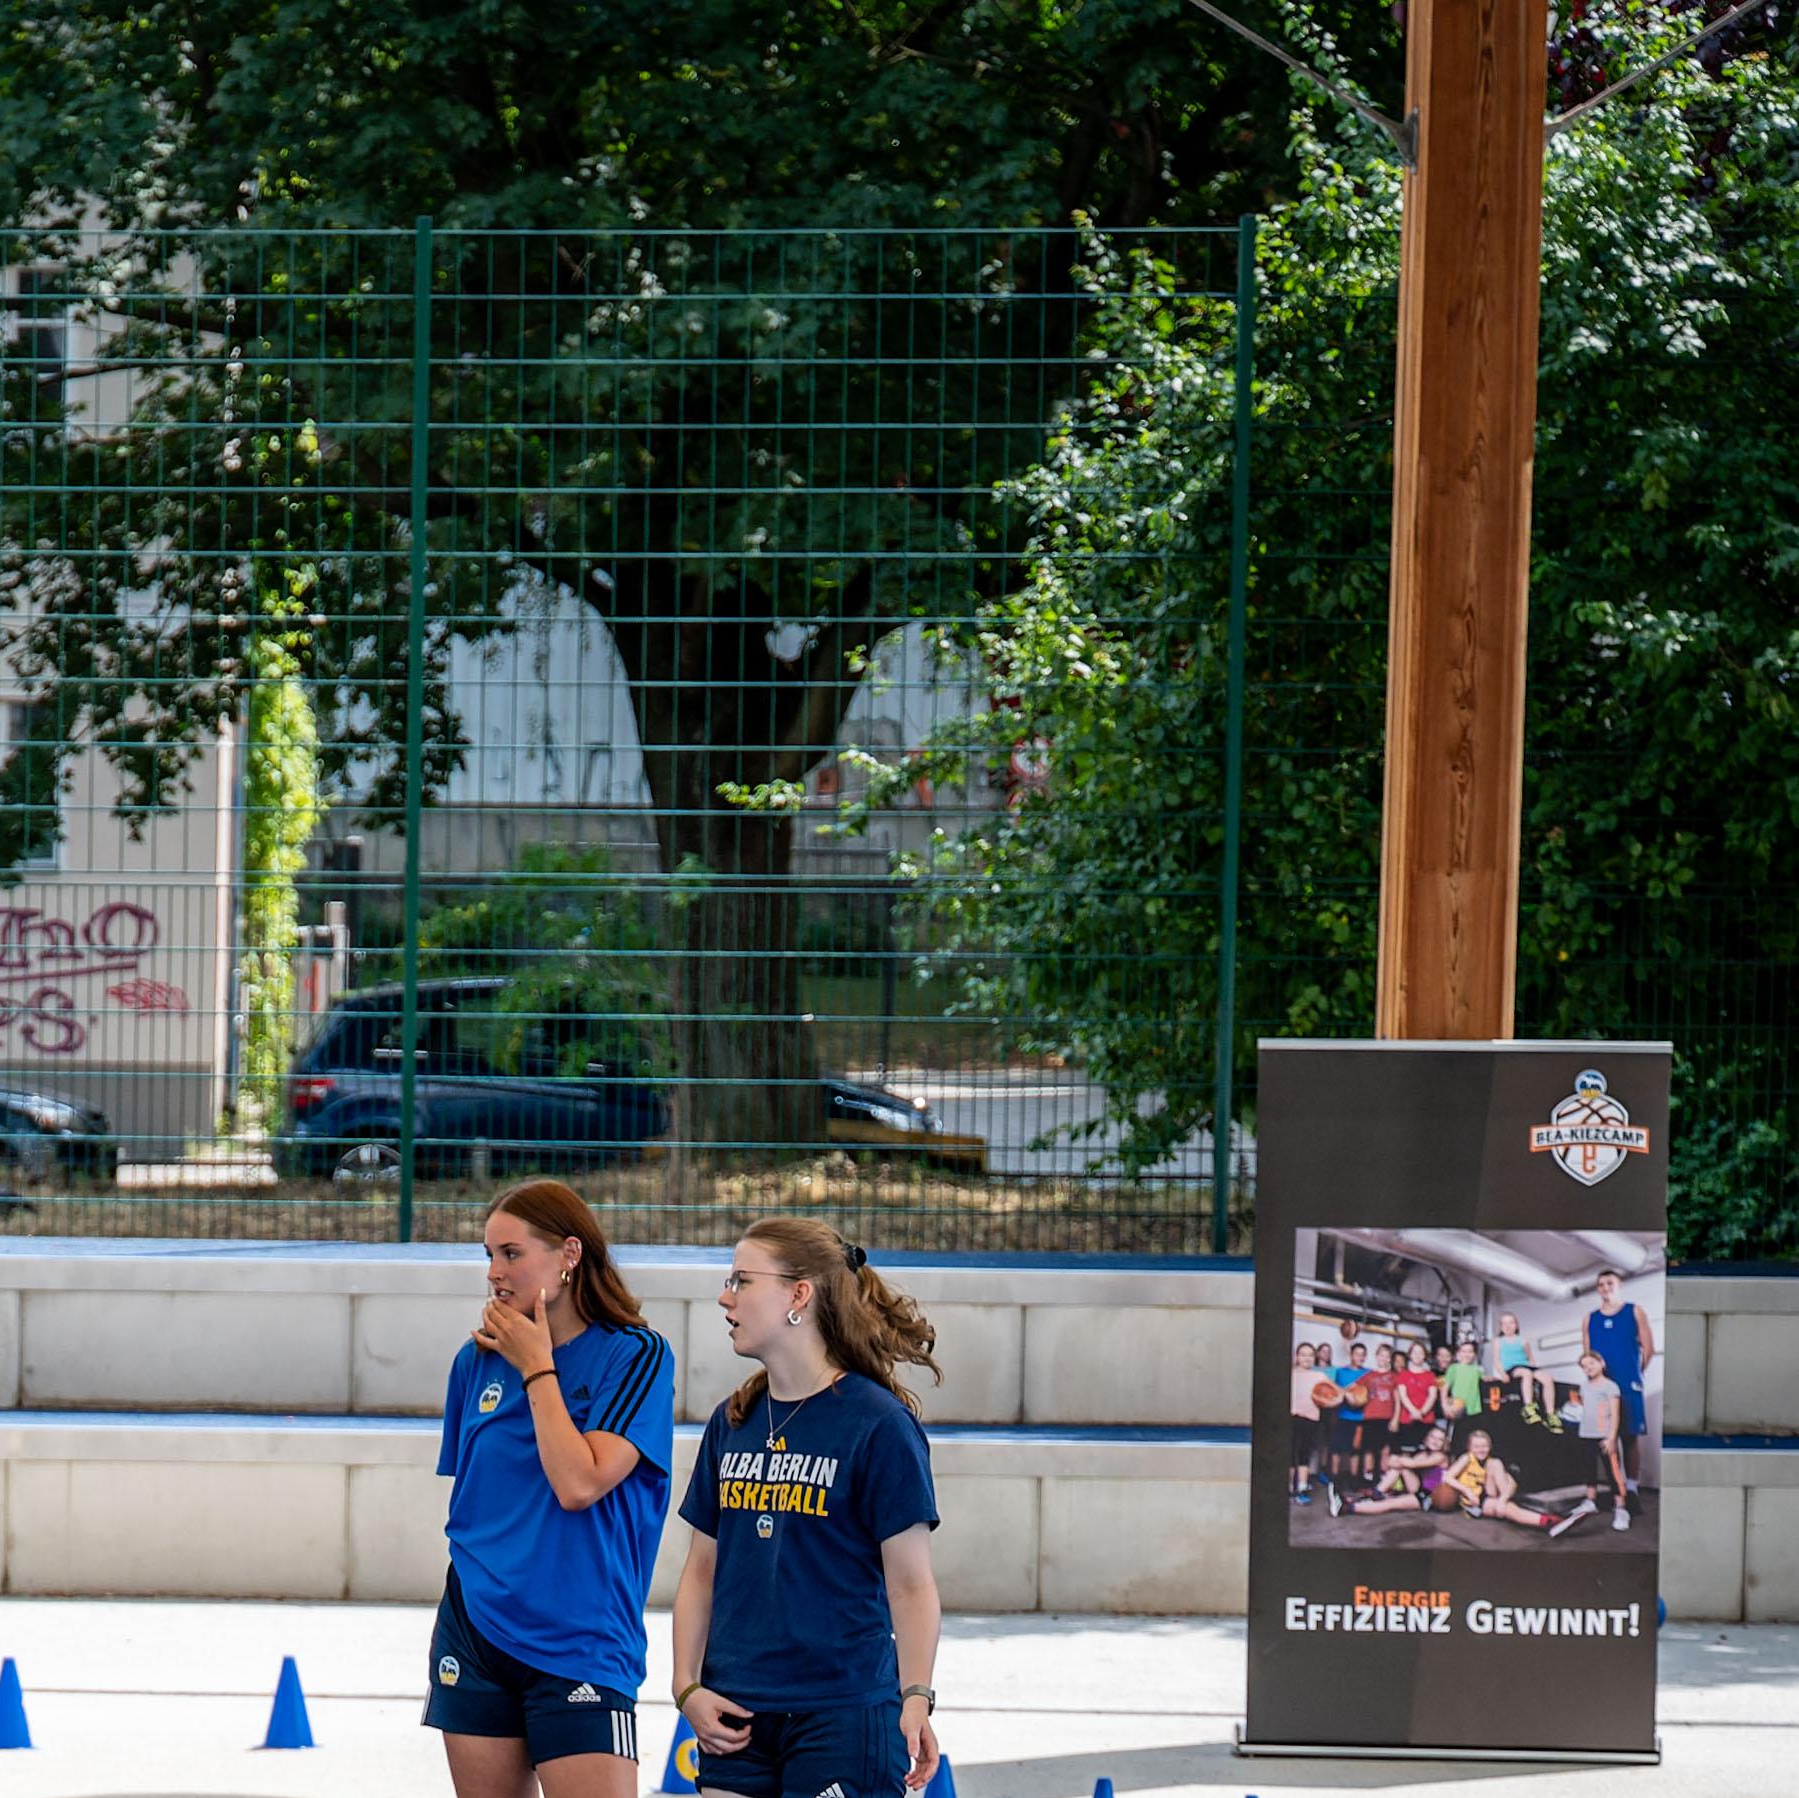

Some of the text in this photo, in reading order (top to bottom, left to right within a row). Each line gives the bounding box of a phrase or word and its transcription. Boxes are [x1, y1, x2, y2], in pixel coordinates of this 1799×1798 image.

[1536, 1127, 1644, 1145] BEA-KIEZCAMP
[719, 1451, 839, 1488] ALBA BERLIN
[719, 1481, 829, 1517] ASKETBALL
[1285, 1596, 1641, 1637] EFFIZIENZ GEWINNT!
